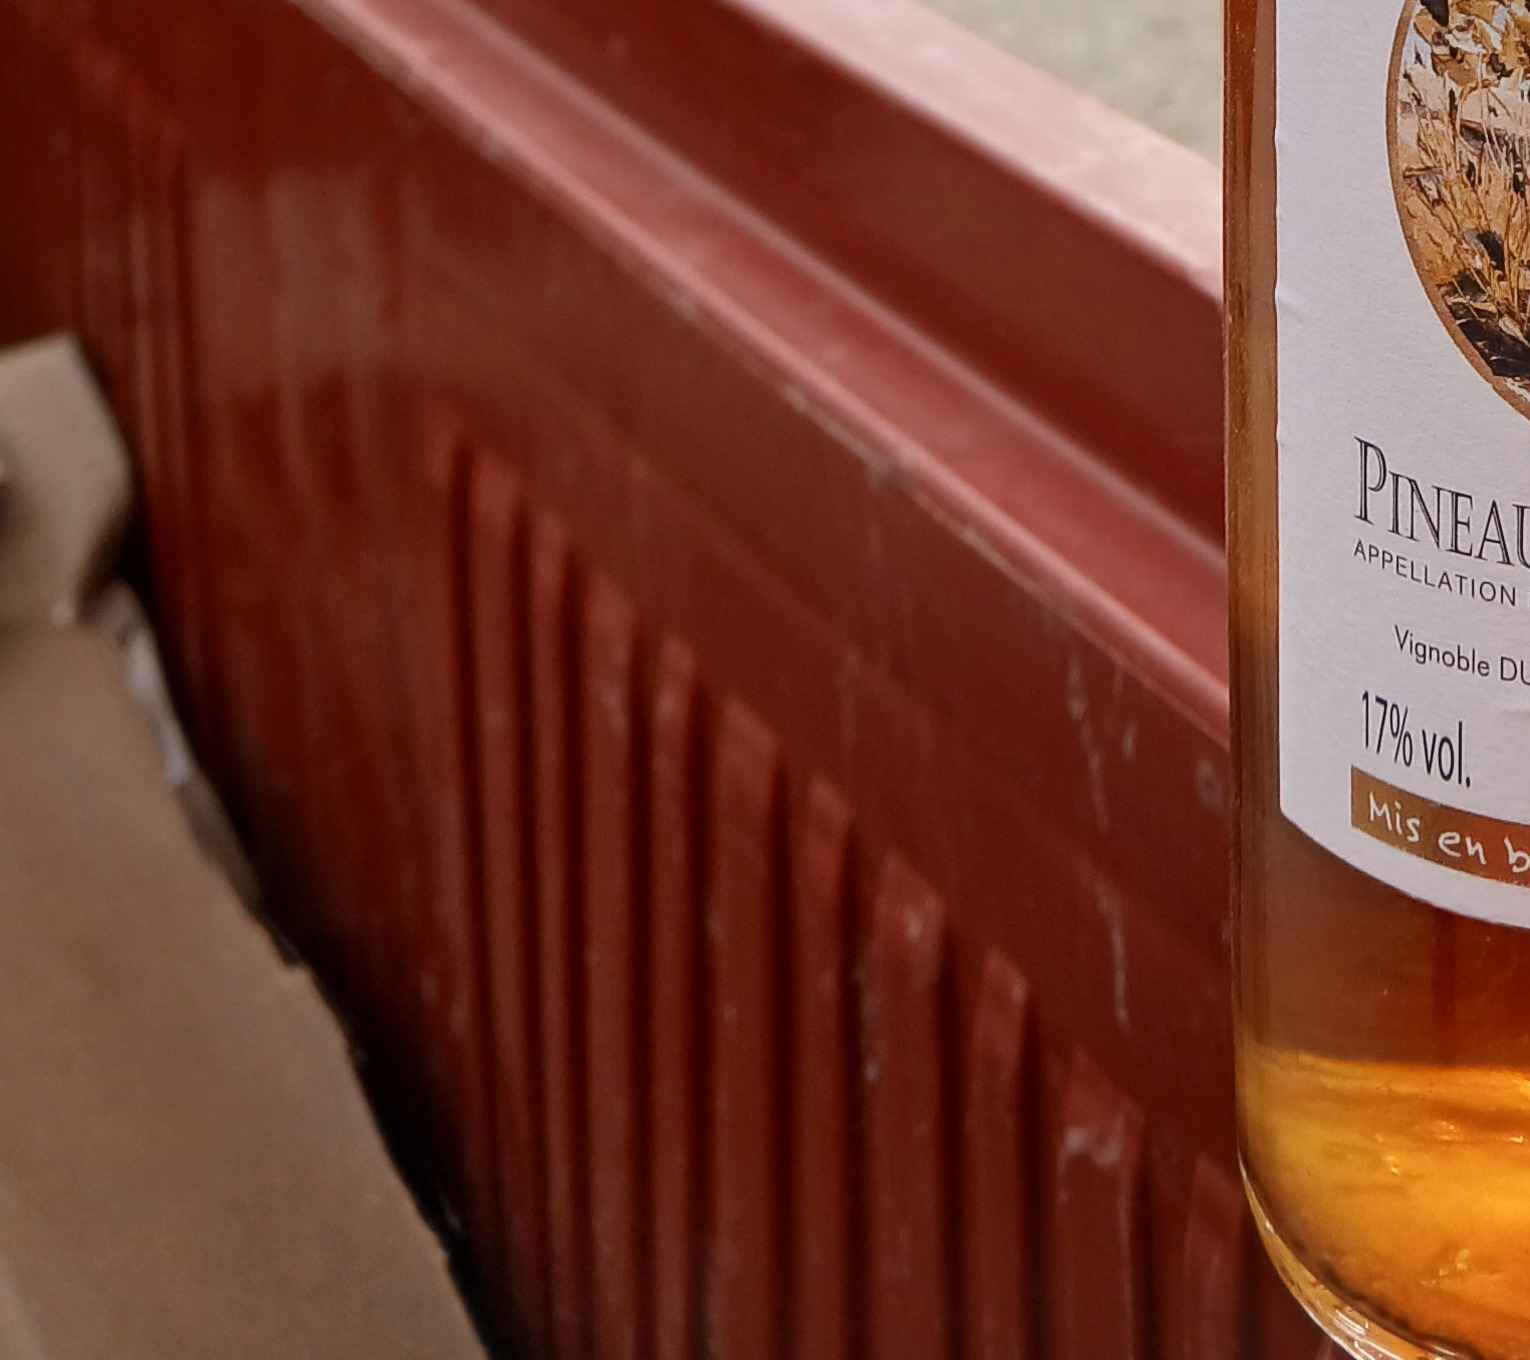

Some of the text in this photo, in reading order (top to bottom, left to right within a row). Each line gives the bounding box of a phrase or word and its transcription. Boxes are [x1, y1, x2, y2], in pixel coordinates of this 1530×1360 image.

[1353, 538, 1518, 608] APPELLATION
[1393, 624, 1491, 678] Vignoble
[1361, 690, 1472, 788] 17% vol.
[1367, 791, 1422, 843] Mis
[1438, 832, 1487, 866] en
